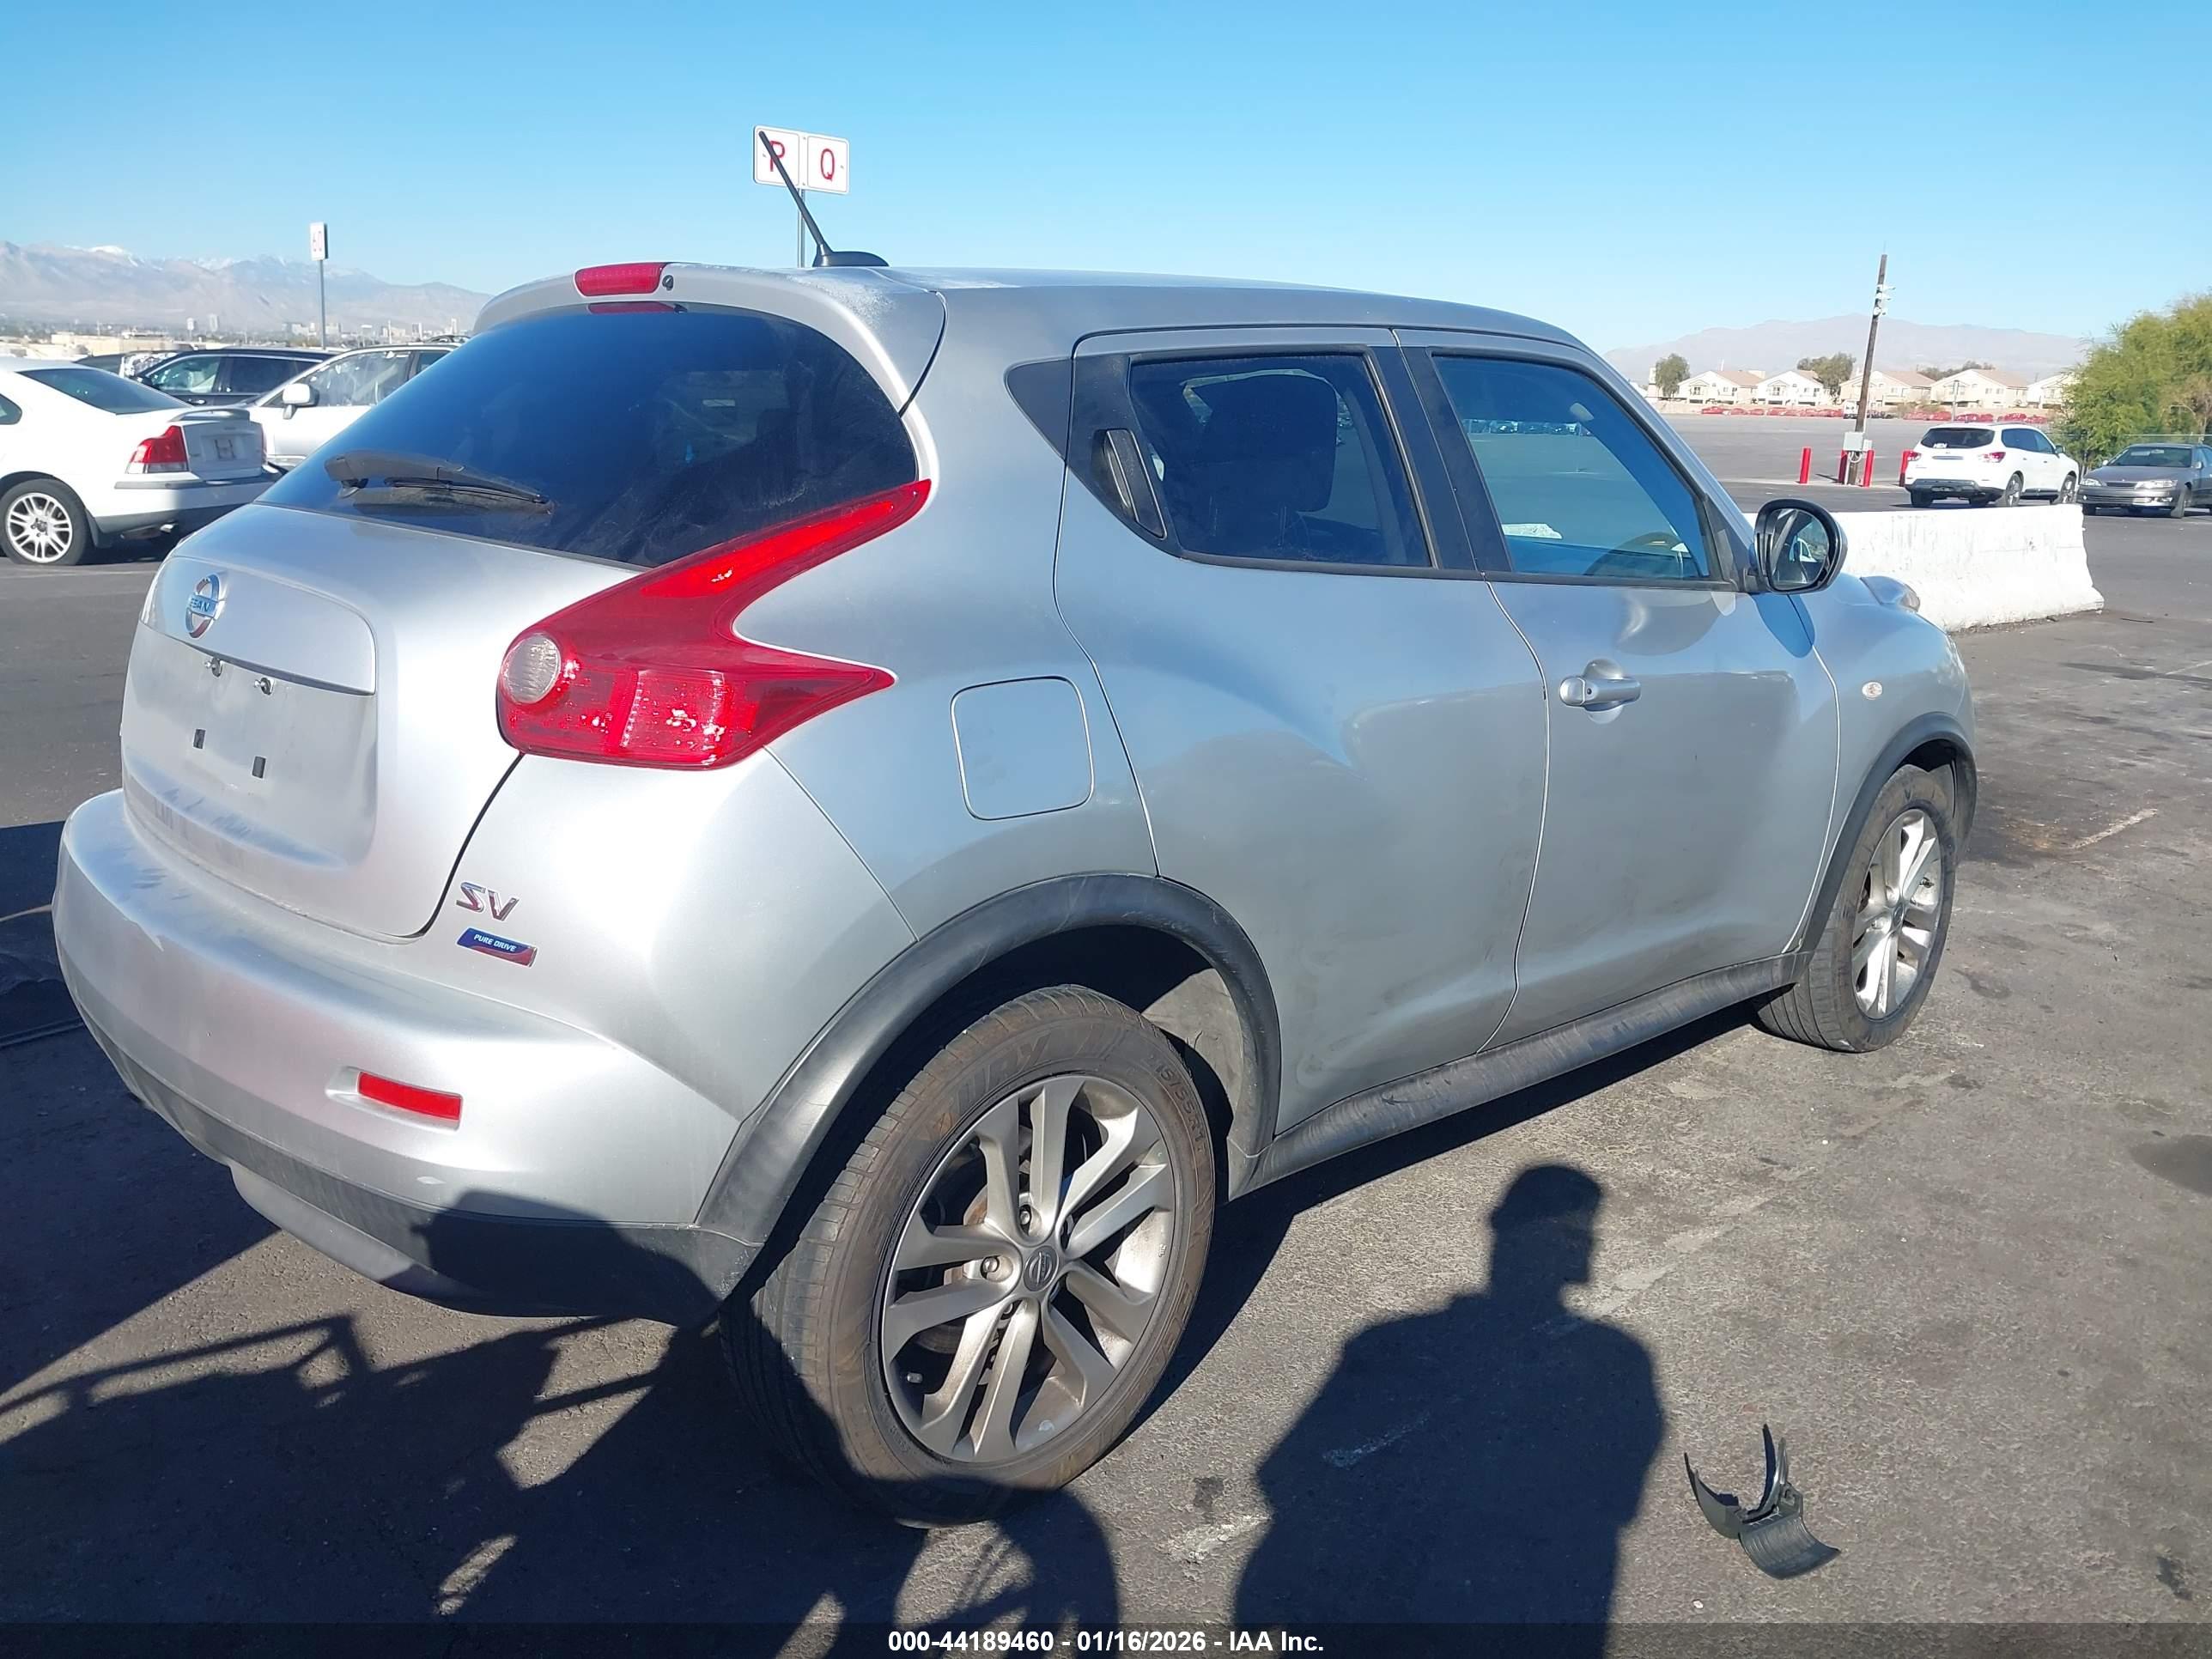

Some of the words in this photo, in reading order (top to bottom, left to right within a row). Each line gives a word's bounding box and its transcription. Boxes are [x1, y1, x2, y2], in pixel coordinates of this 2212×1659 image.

[769, 140, 786, 173] P
[820, 148, 836, 181] Q
[455, 881, 520, 921] SV
[473, 933, 494, 945] PURE
[493, 940, 517, 952] DRIVE
